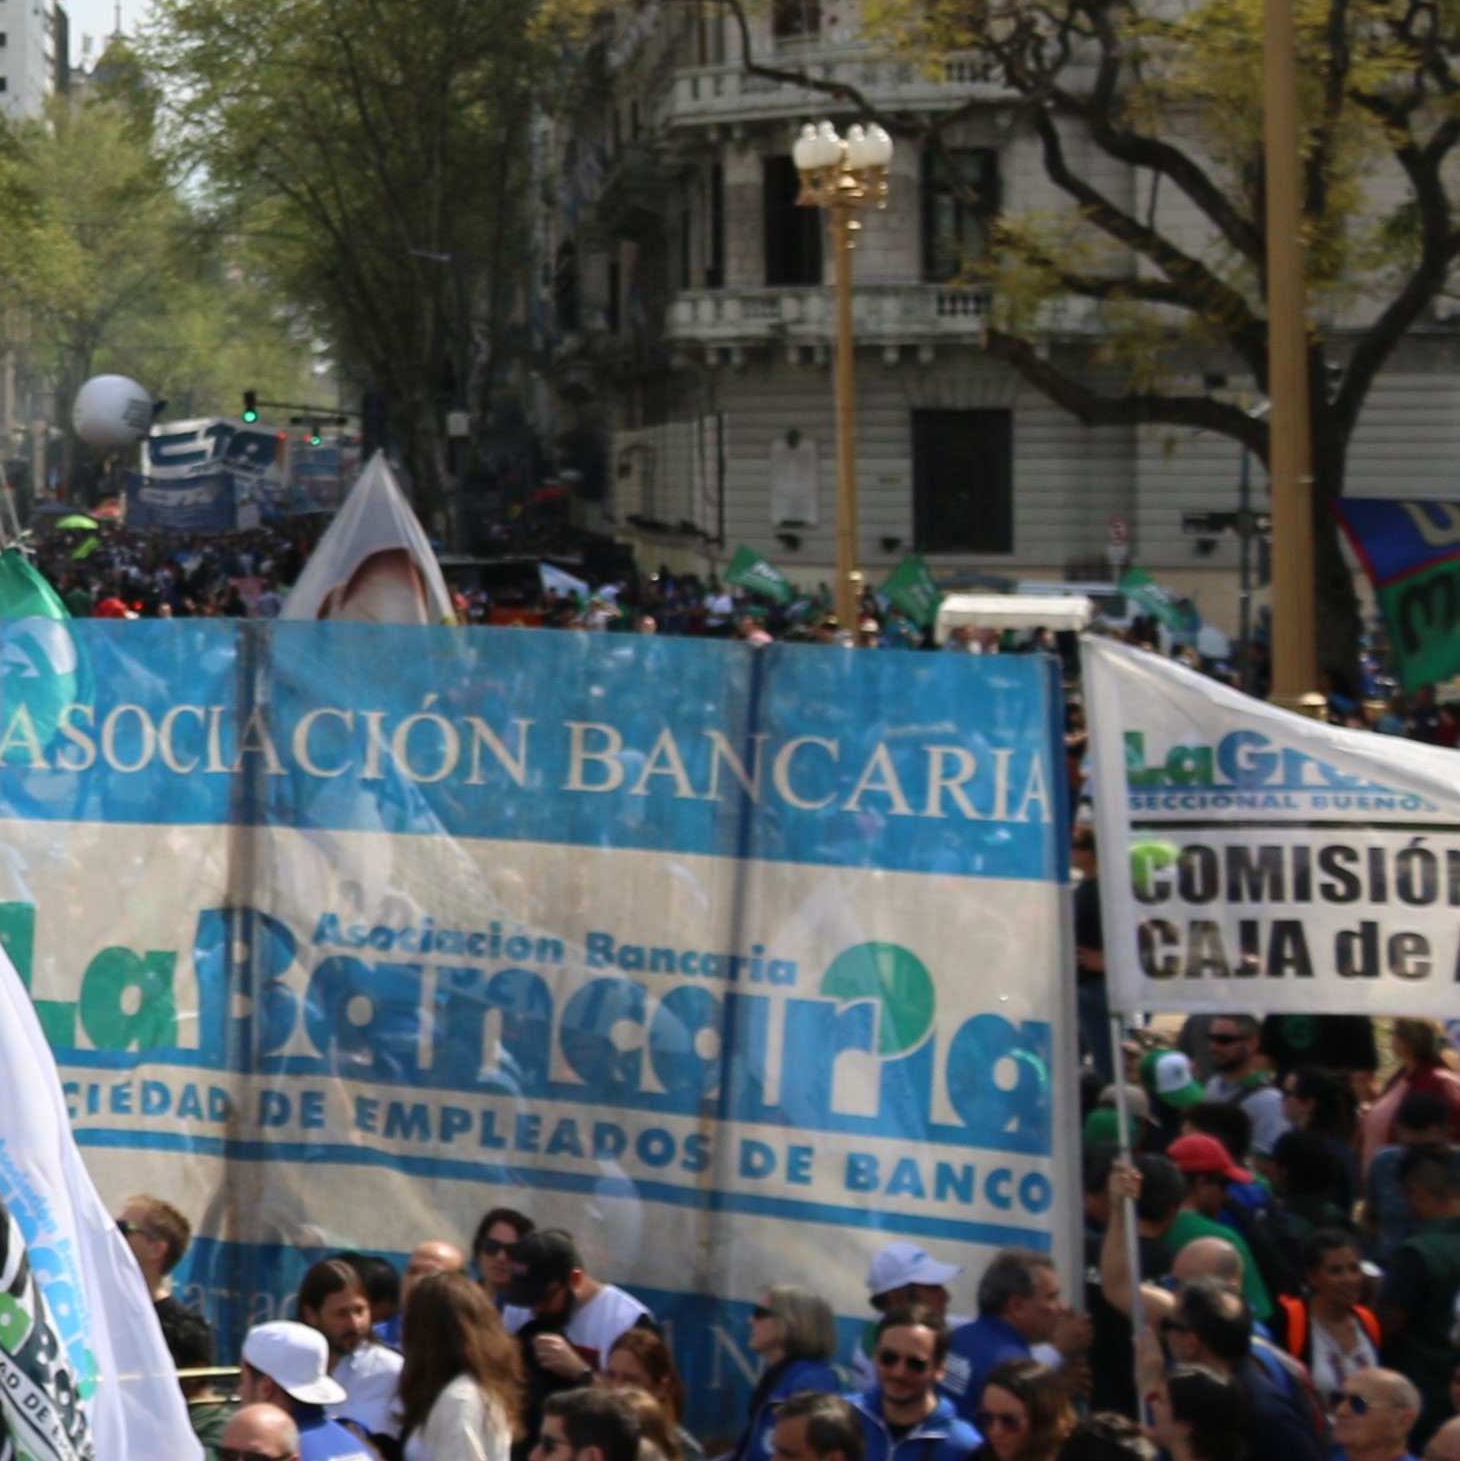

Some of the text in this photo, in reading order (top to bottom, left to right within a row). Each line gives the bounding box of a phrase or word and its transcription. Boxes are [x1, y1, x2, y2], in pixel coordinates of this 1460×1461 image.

[562, 720, 1054, 824] BANCARIA
[1129, 794, 1440, 813] SECCIONAL BUENOS
[312, 912, 798, 987] Asociación Bancaria
[1137, 917, 1433, 980] CAJA de
[260, 1089, 325, 1129] DE
[354, 1096, 714, 1174] EMPLEADOS
[740, 1140, 814, 1185] DE
[845, 1151, 1052, 1216] BANCO
